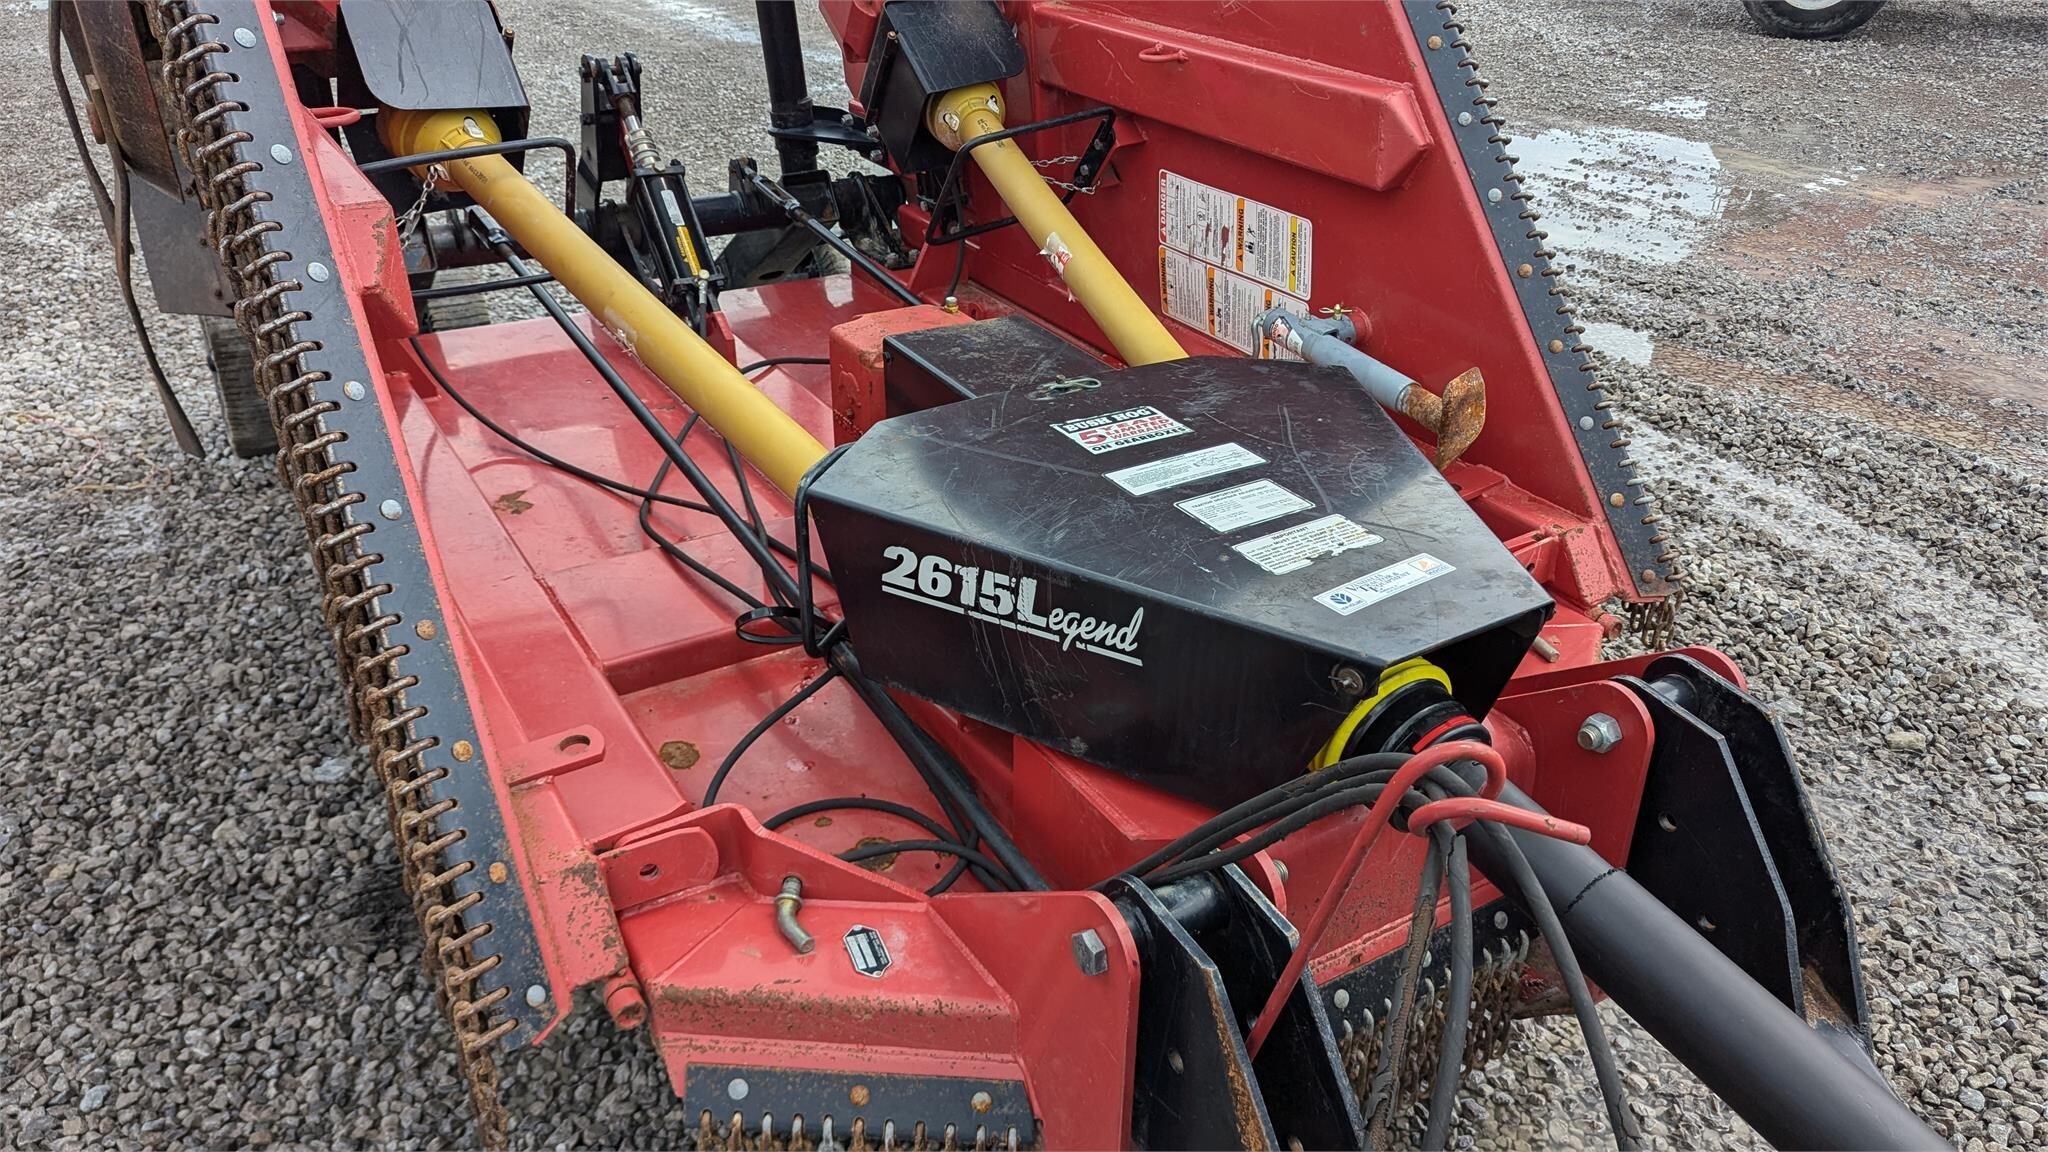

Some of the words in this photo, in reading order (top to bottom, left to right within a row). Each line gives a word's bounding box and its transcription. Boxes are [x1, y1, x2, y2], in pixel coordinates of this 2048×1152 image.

[1063, 417, 1111, 432] BUSH
[1112, 408, 1151, 421] HOG
[1102, 415, 1163, 432] YEAR
[1106, 418, 1170, 436] LIMITED
[1079, 429, 1107, 445] 5
[1092, 444, 1111, 452] ON
[1114, 427, 1187, 446] GEARBOXES
[1110, 422, 1175, 440] WARRANTY
[1271, 526, 1309, 540] IMPORTANT
